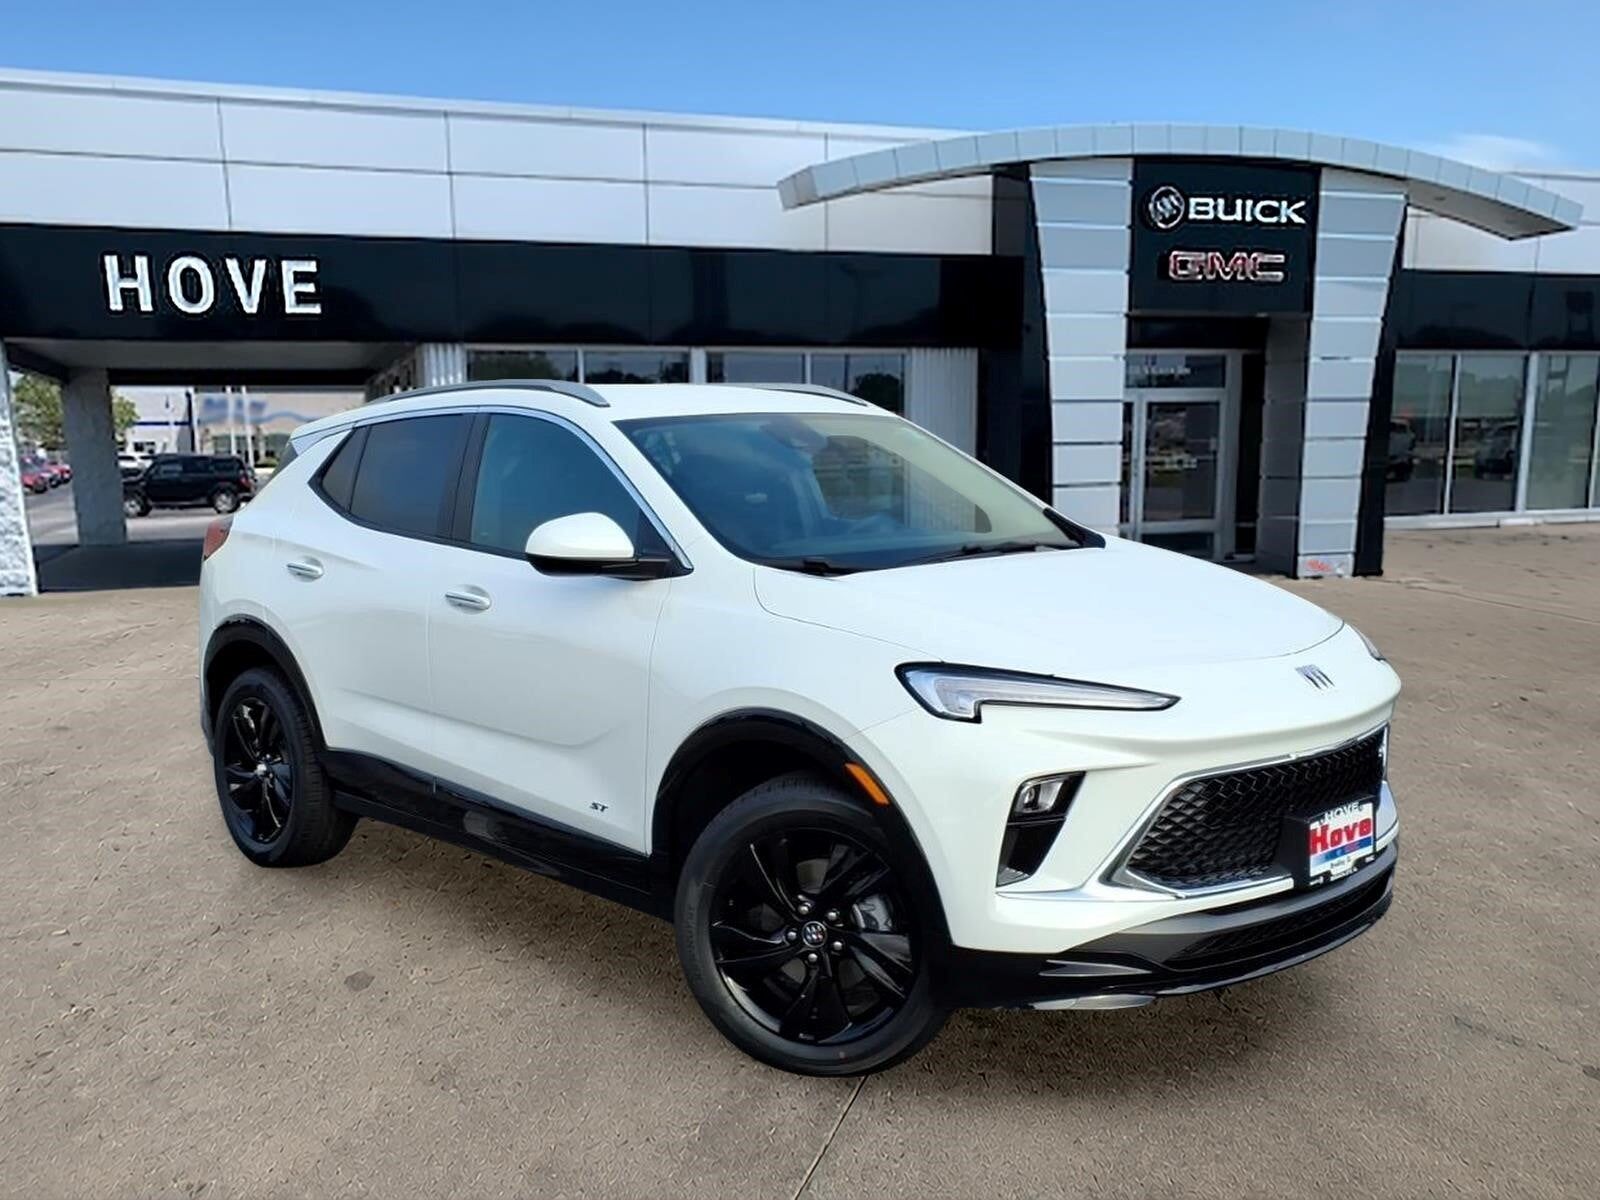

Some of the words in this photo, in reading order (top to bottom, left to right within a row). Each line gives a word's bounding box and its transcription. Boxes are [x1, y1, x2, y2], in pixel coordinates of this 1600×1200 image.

[1188, 197, 1306, 224] BUICK
[1168, 251, 1285, 282] GMC
[104, 255, 322, 314] HOVE
[590, 802, 609, 812] ST
[1323, 801, 1360, 820] HOVE
[1309, 818, 1372, 855] Hove
